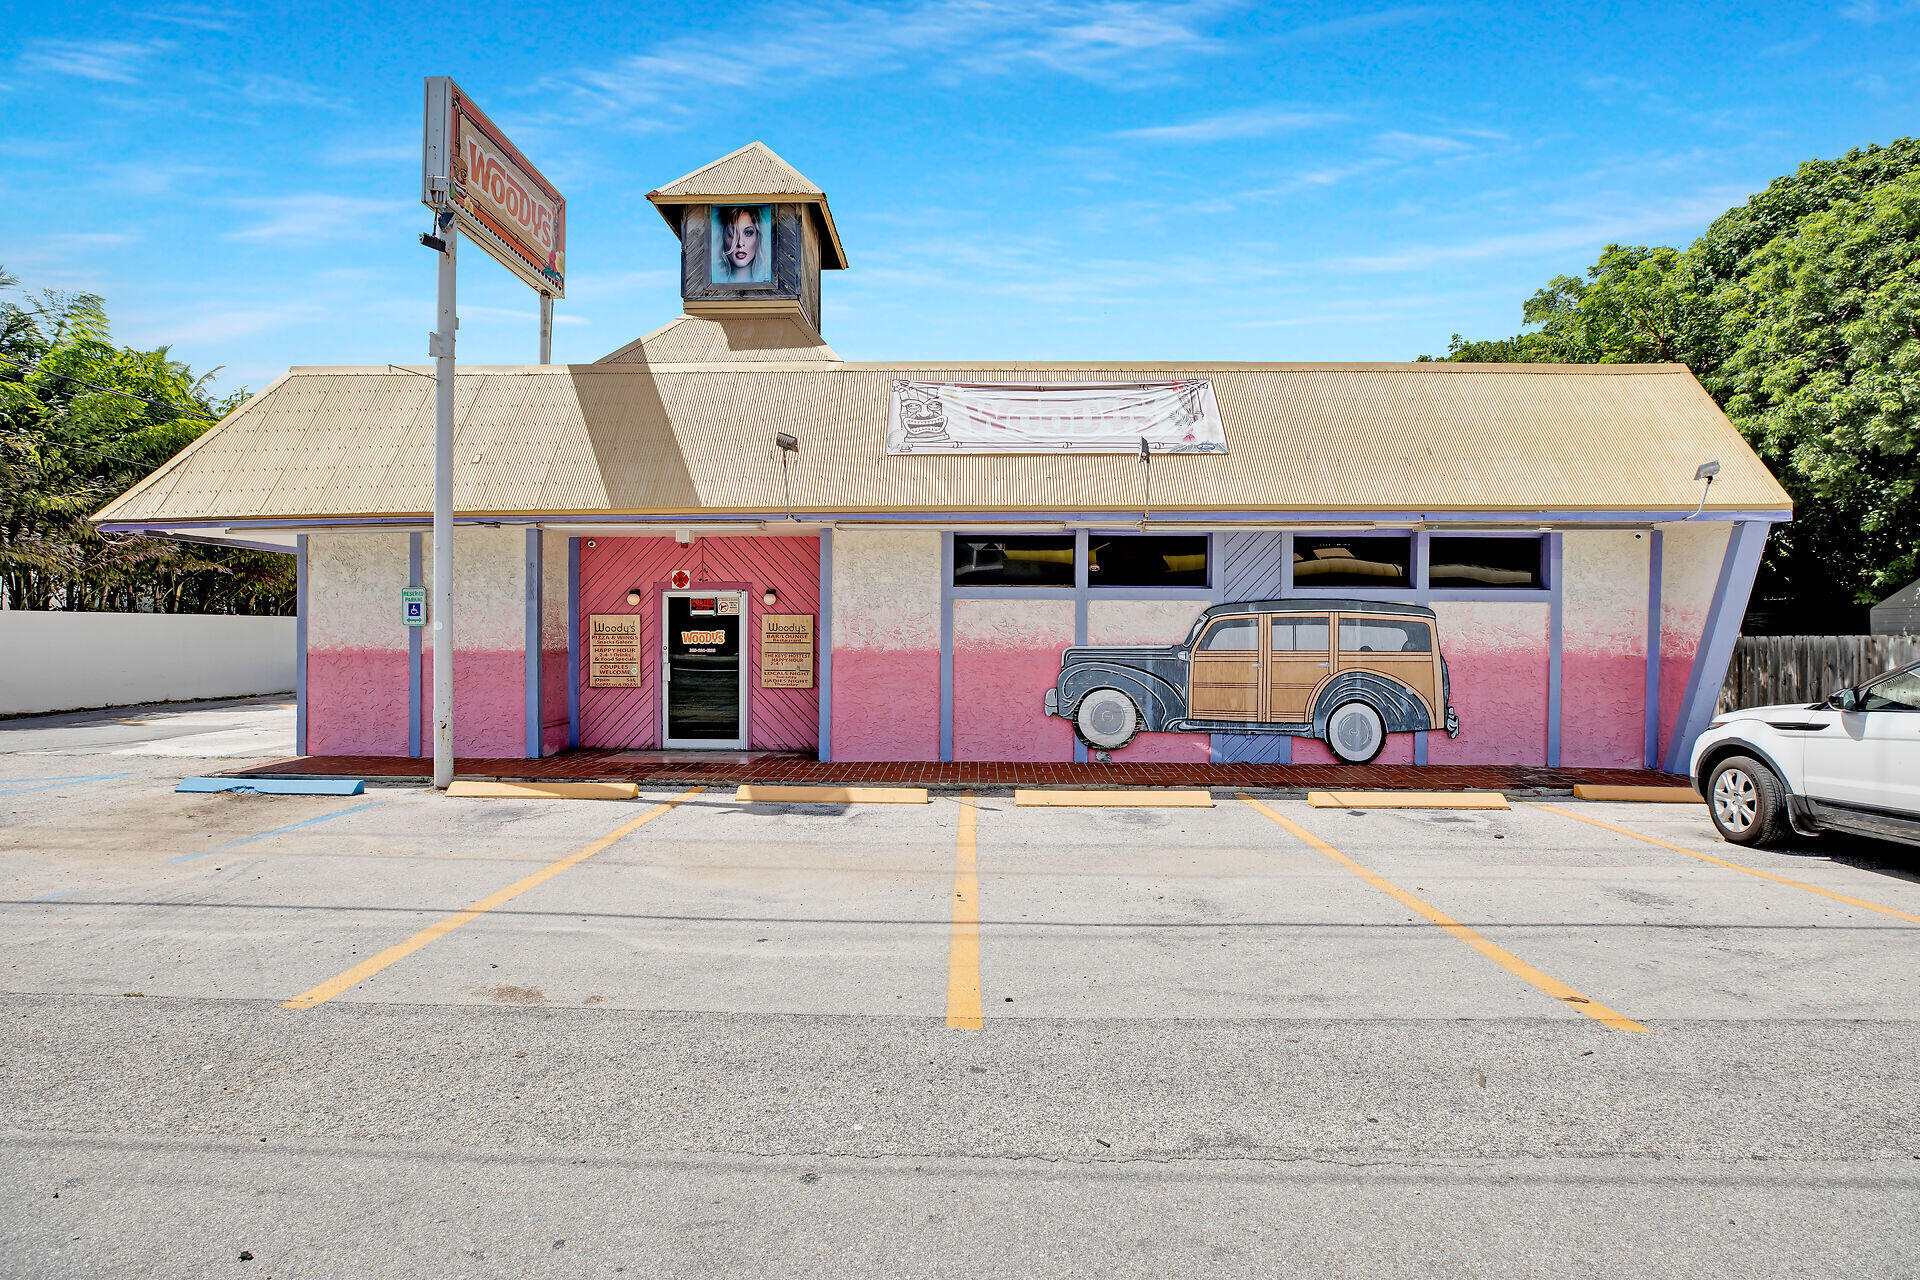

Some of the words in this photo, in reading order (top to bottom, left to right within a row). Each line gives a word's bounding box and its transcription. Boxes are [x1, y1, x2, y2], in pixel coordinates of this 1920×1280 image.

[467, 138, 552, 248] WOODY'S
[594, 621, 636, 634] Woody's
[768, 623, 806, 633] Woody's
[681, 630, 725, 644] WOODY'S
